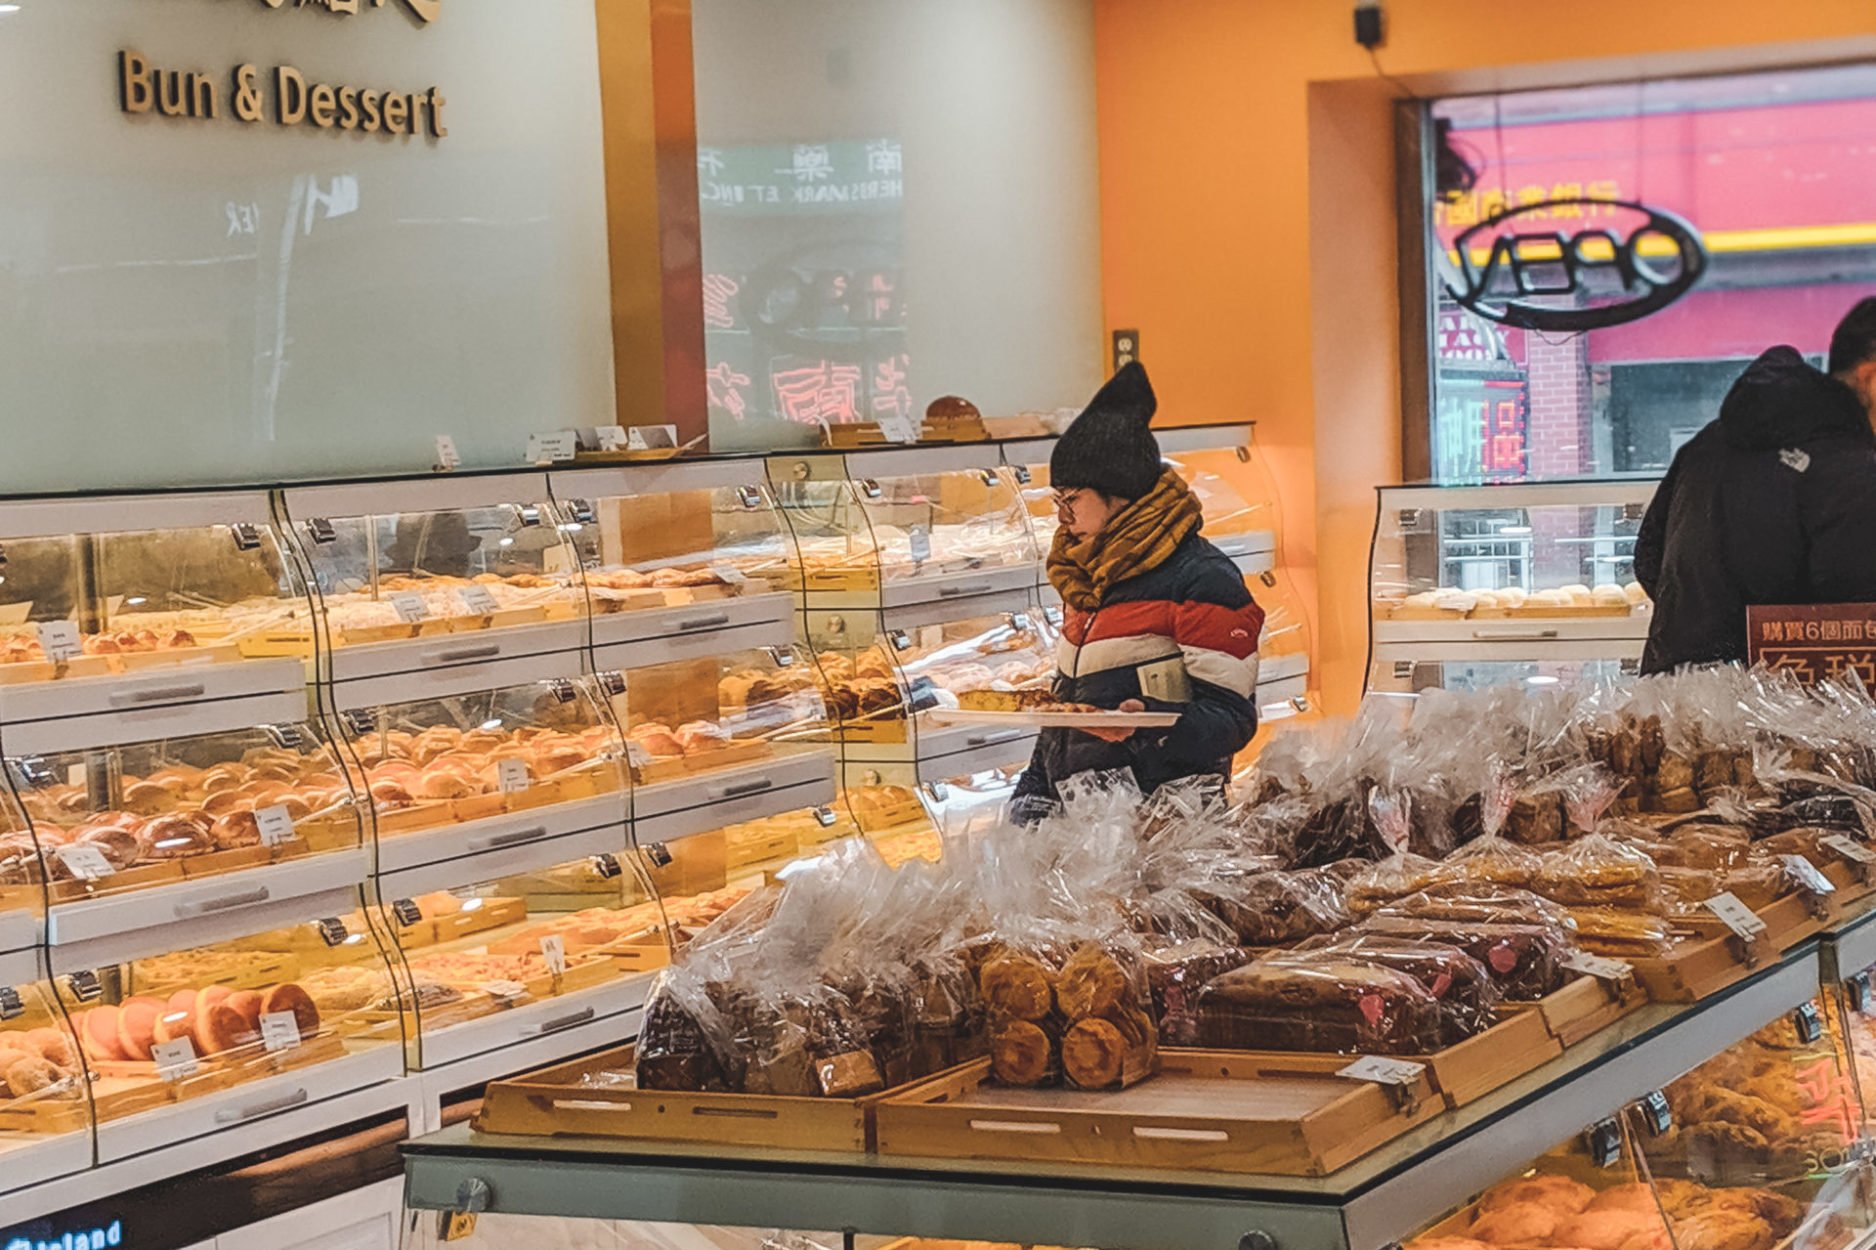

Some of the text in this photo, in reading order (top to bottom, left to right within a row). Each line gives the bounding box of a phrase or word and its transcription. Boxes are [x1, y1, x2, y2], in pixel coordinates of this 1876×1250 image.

[118, 50, 448, 137] Bun & Dessert
